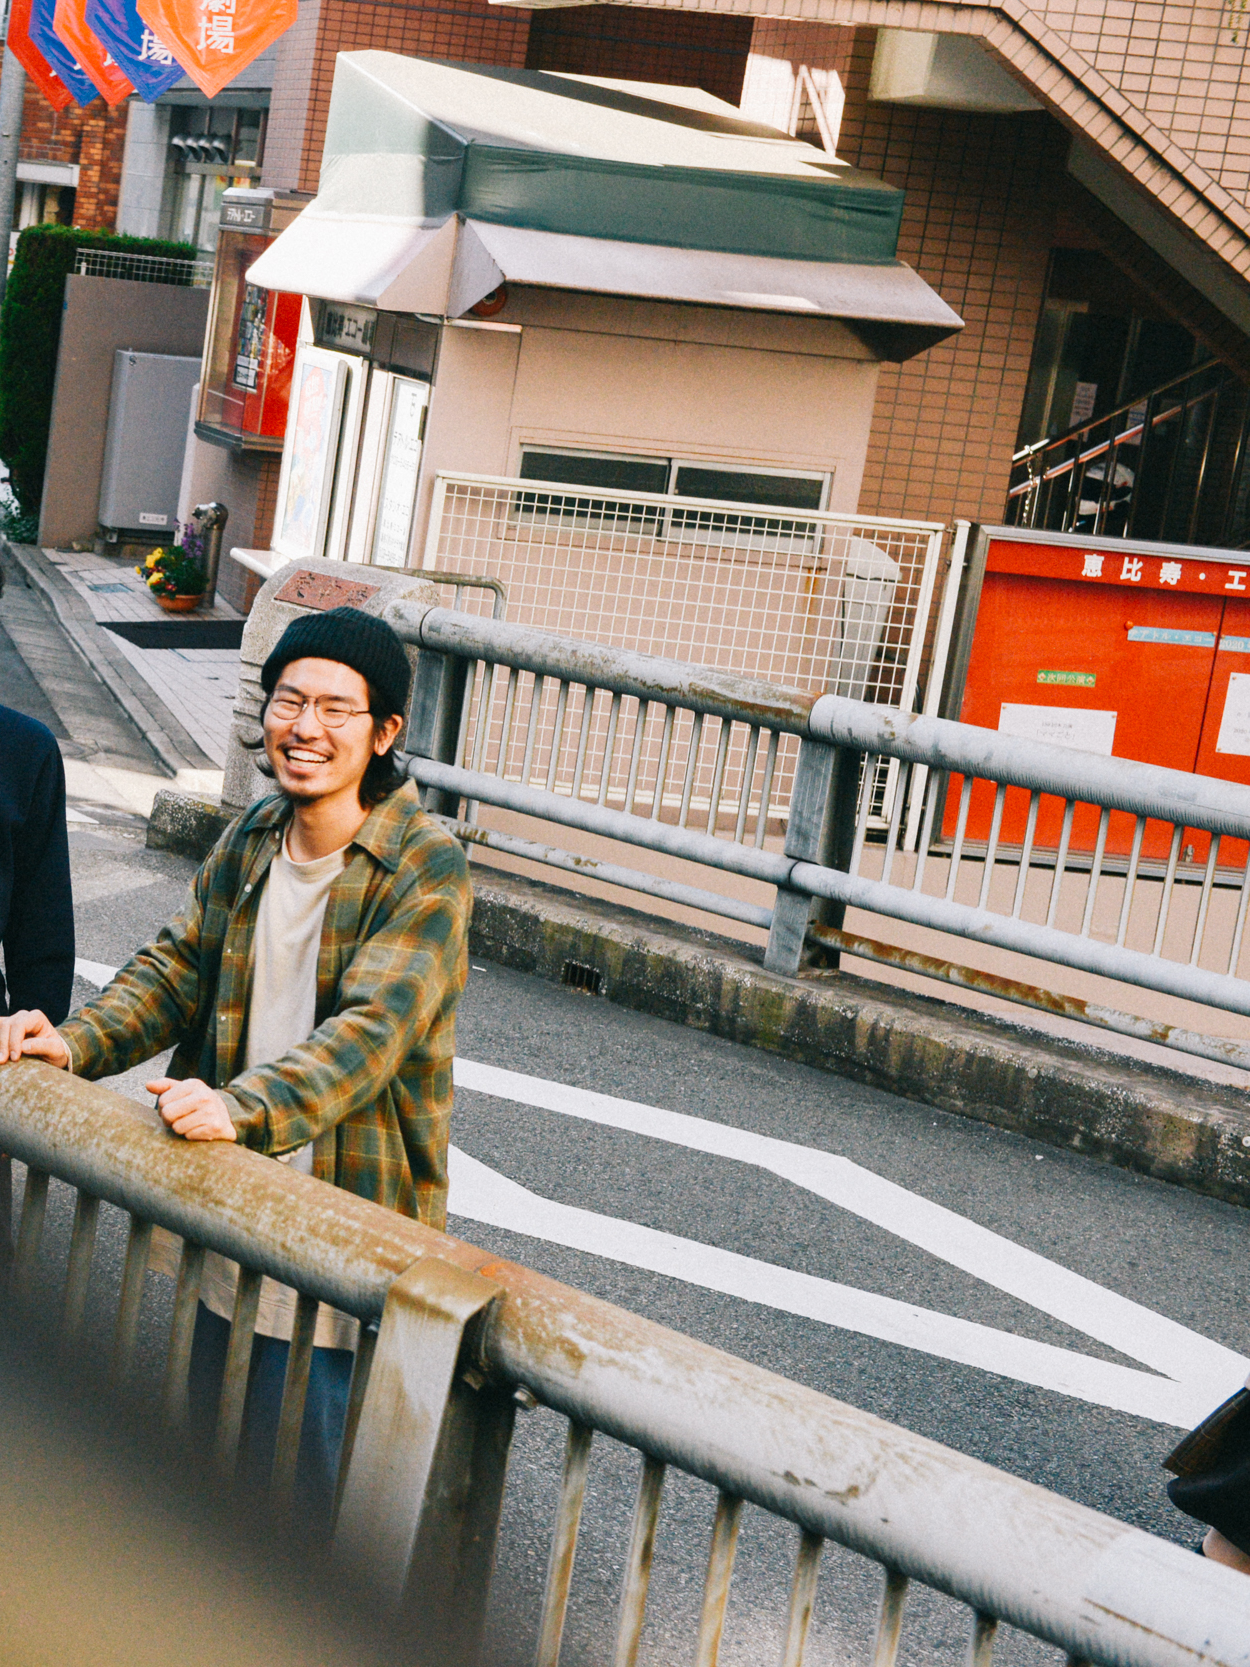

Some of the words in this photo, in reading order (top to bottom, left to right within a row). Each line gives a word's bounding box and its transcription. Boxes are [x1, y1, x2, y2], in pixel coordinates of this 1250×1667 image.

[1081, 553, 1248, 591] 恵比寿・エ
[1220, 638, 1245, 650] 2020
